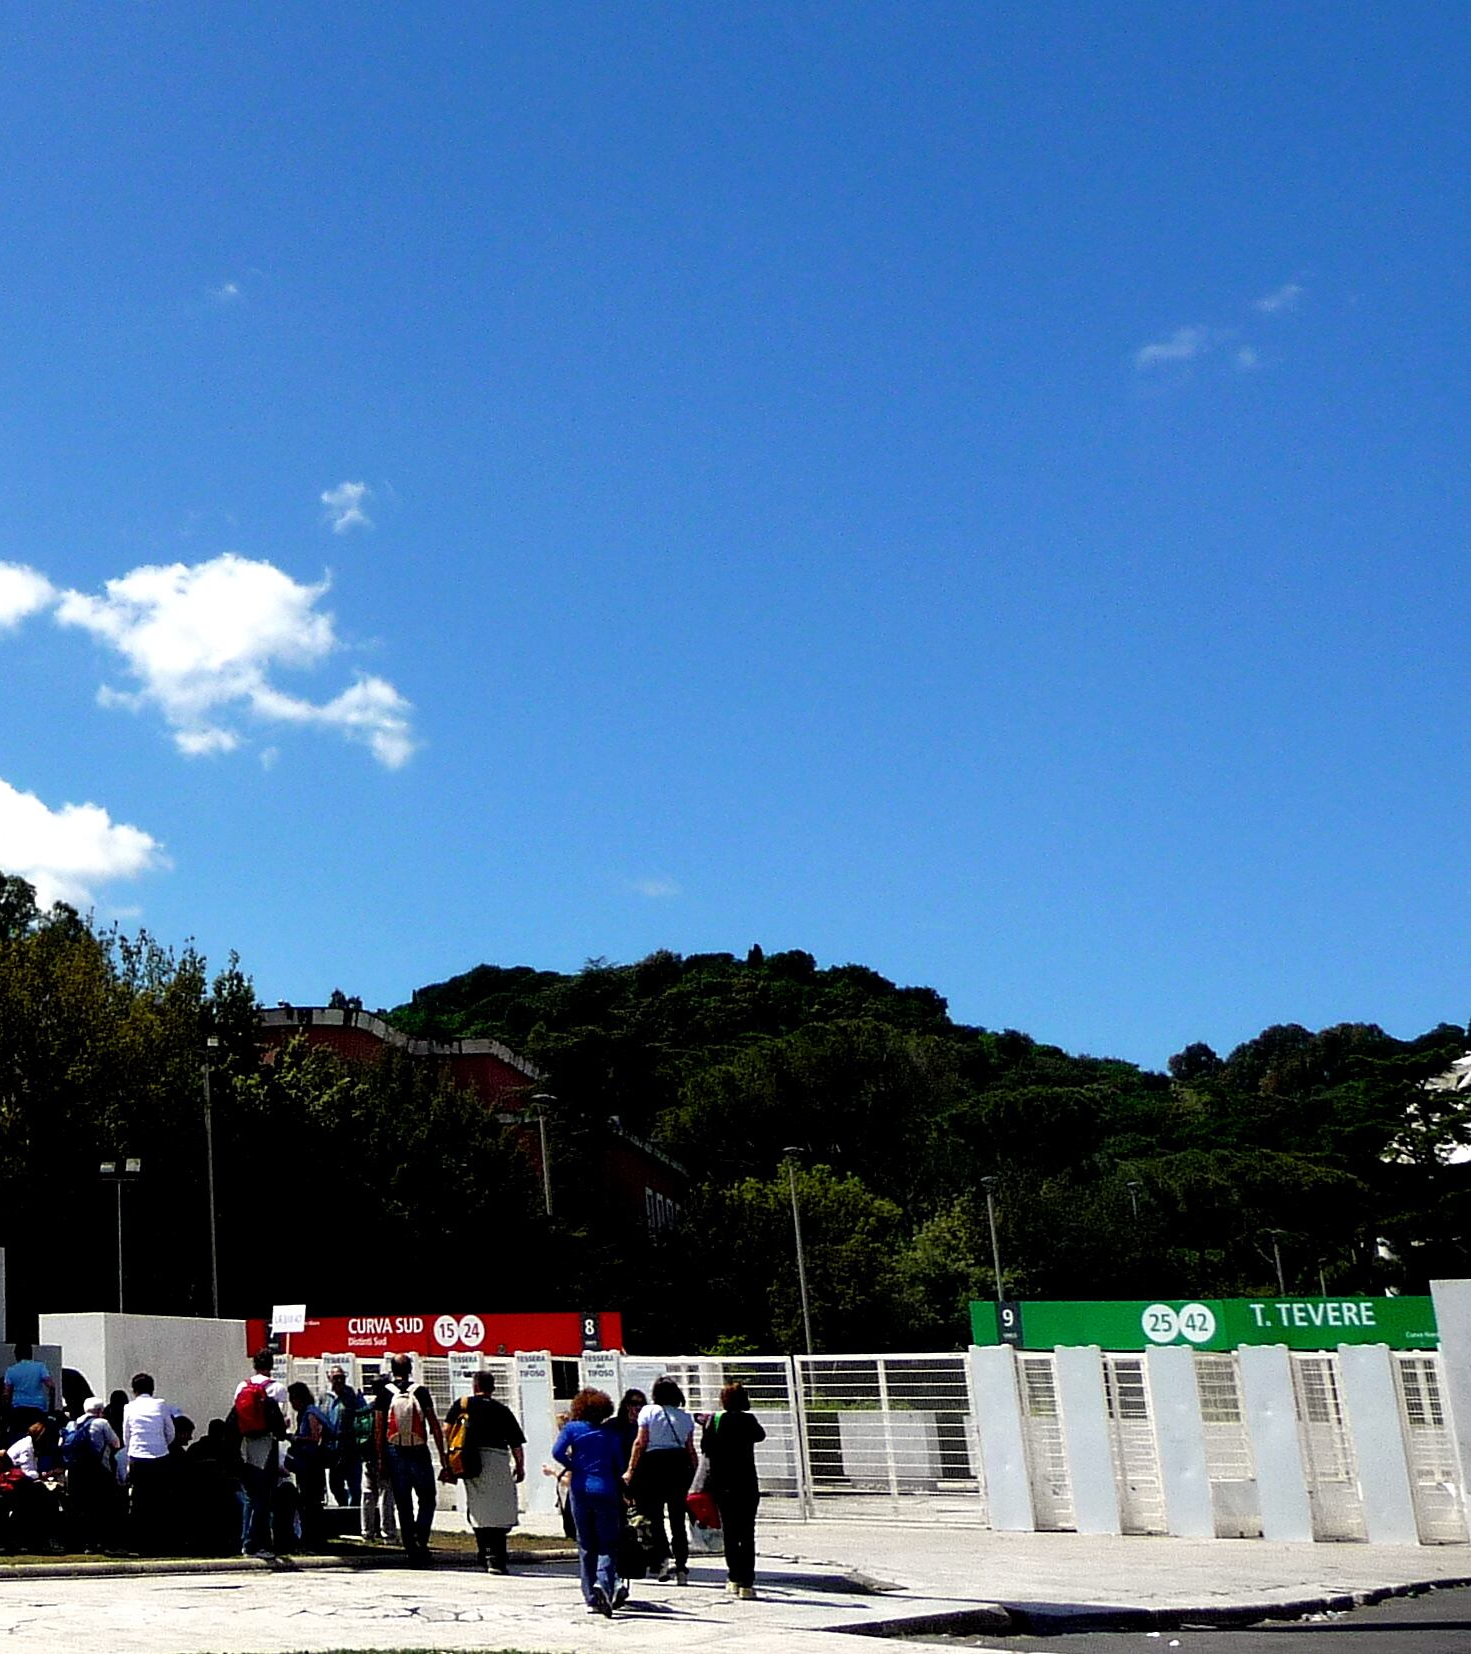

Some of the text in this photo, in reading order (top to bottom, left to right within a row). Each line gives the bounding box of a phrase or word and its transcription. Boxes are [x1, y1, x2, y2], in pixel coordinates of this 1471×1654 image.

[1002, 1308, 1014, 1327] 9
[1148, 1313, 1208, 1332] 25 42
[1249, 1302, 1377, 1327] T. TEVERE
[348, 1317, 424, 1335] CURVA SUD
[439, 1322, 480, 1339] 15 24
[584, 1318, 595, 1335] 8
[348, 1337, 388, 1346] Distinti Sud
[519, 1369, 546, 1377] TIFOSO
[588, 1369, 614, 1377] TIFOSO
